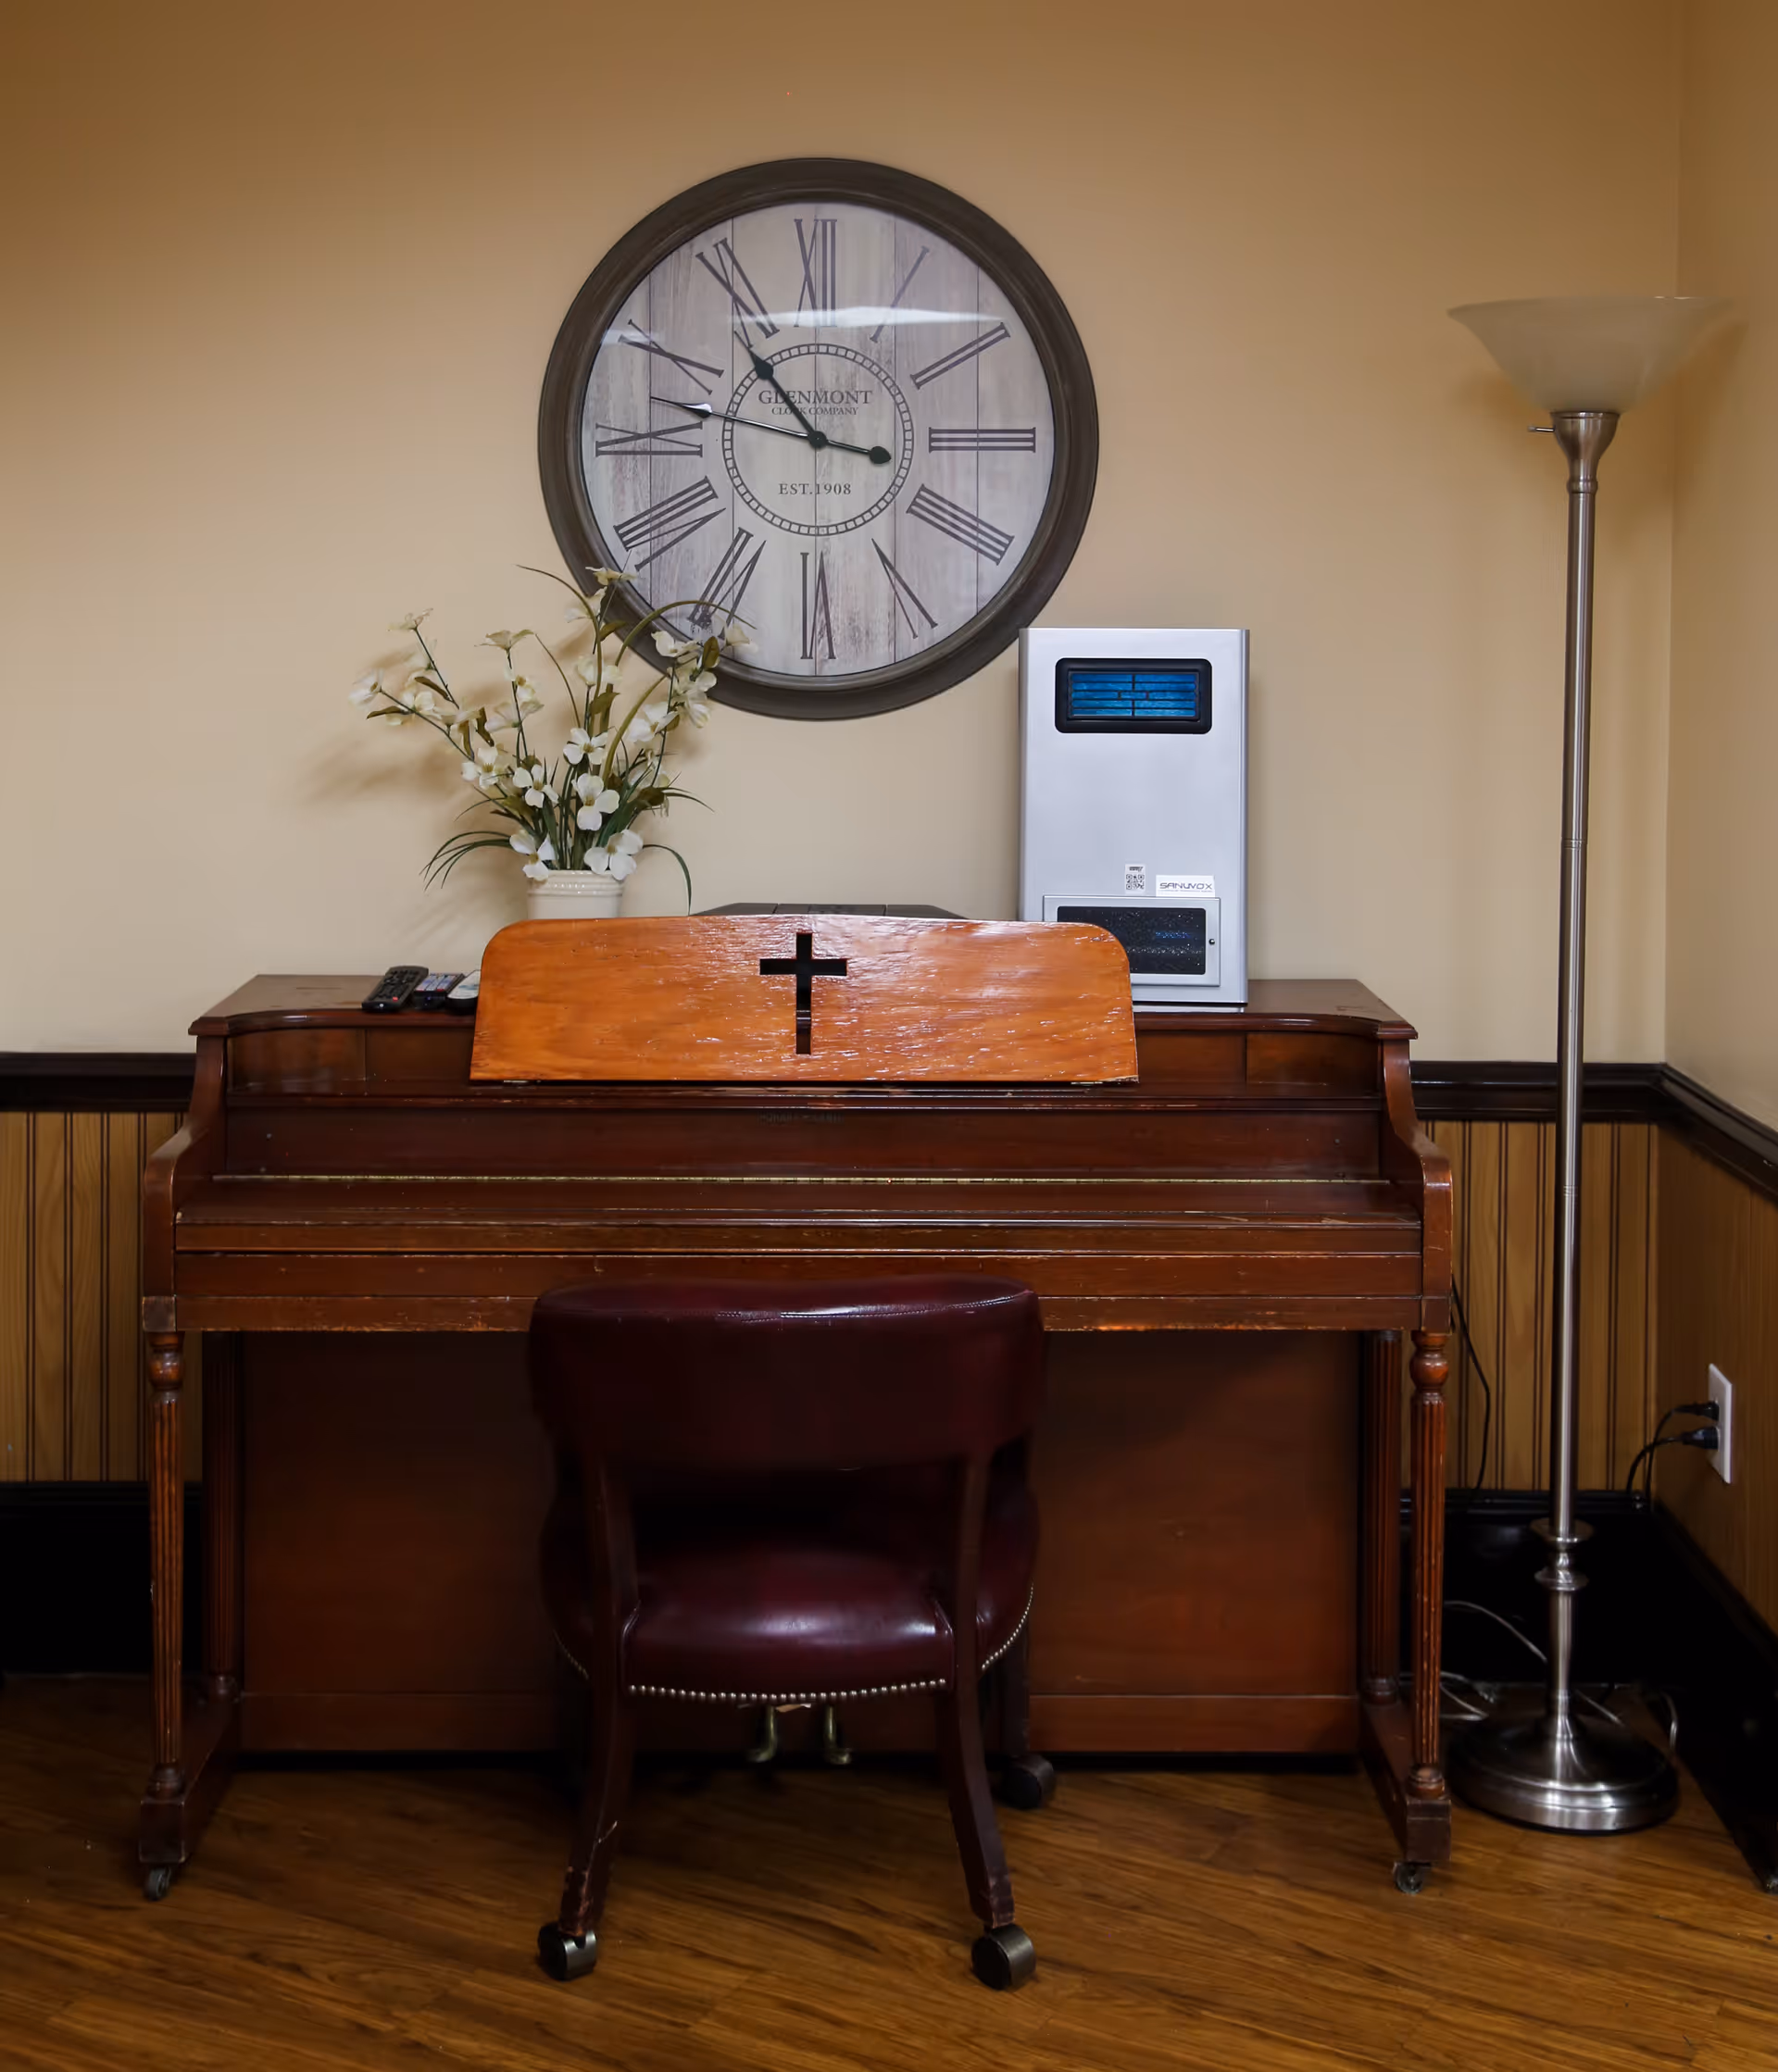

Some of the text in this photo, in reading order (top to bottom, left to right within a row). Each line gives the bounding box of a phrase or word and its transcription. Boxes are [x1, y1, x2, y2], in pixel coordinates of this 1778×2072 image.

[695, 237, 781, 348] XI
[794, 218, 837, 327] XII
[909, 321, 1011, 389] II
[771, 406, 858, 416] CLOK COMPANY
[928, 427, 1036, 453] III
